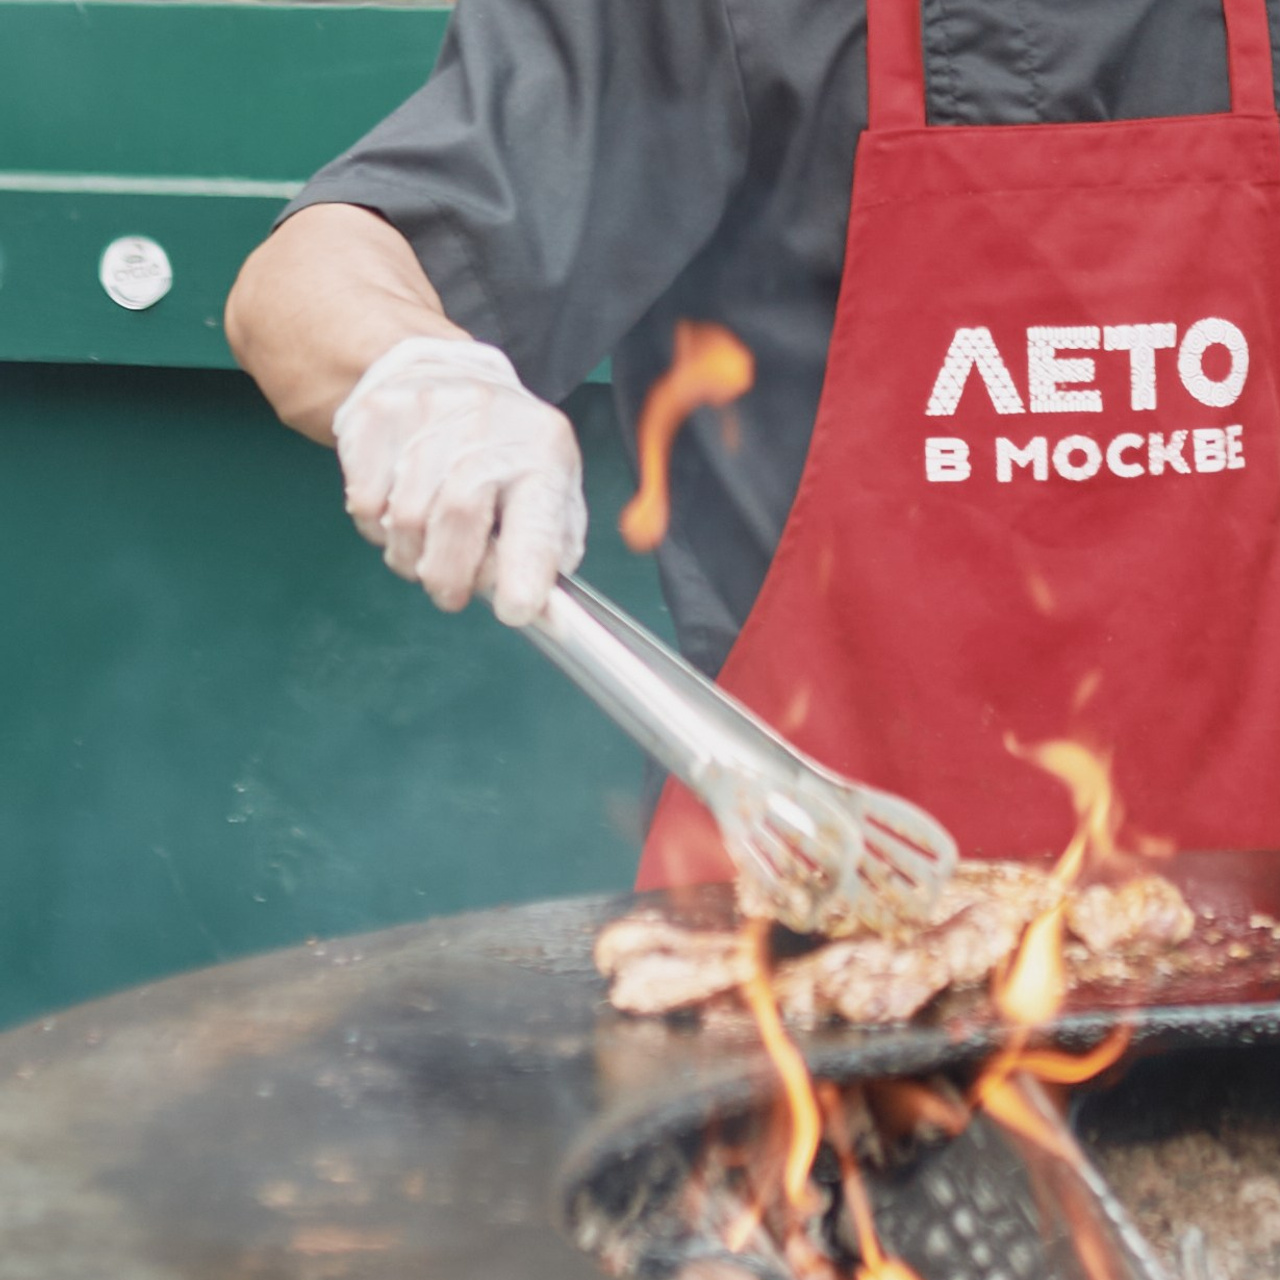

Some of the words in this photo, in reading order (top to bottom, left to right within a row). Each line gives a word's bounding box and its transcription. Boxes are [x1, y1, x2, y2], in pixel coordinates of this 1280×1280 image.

[925, 317, 1249, 416] ЛЕТО
[925, 437, 971, 482] В
[995, 425, 1245, 483] МОСКВЕ
